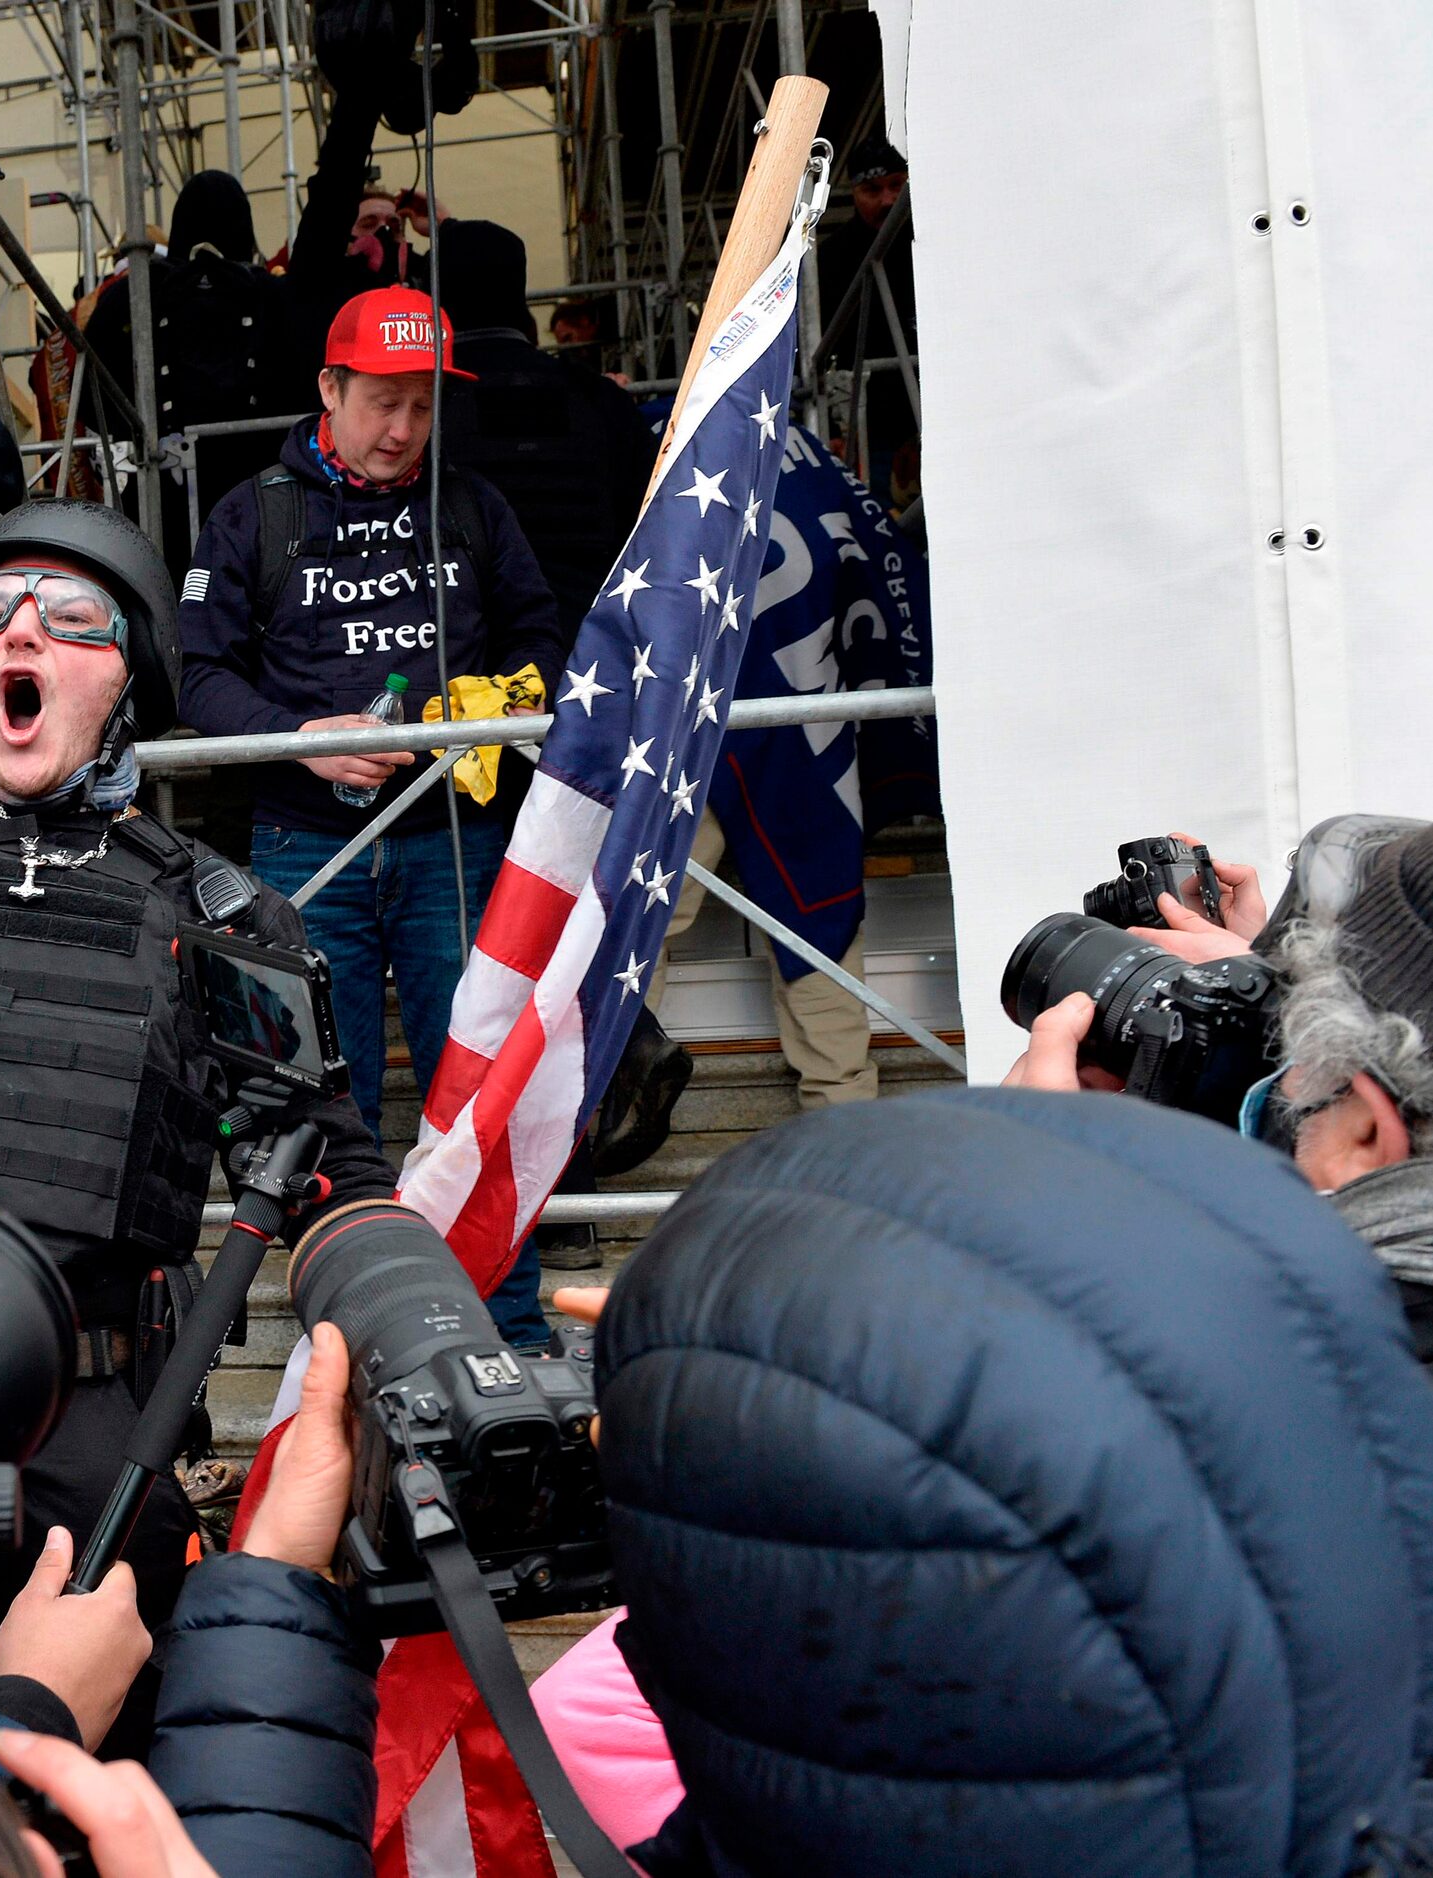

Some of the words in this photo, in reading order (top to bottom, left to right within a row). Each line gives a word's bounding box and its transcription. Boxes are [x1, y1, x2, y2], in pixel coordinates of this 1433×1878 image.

[386, 344, 403, 352] KEEP
[709, 313, 755, 357] Annin
[336, 505, 414, 557] 1776
[301, 561, 460, 606] Forever
[341, 621, 438, 655] Free
